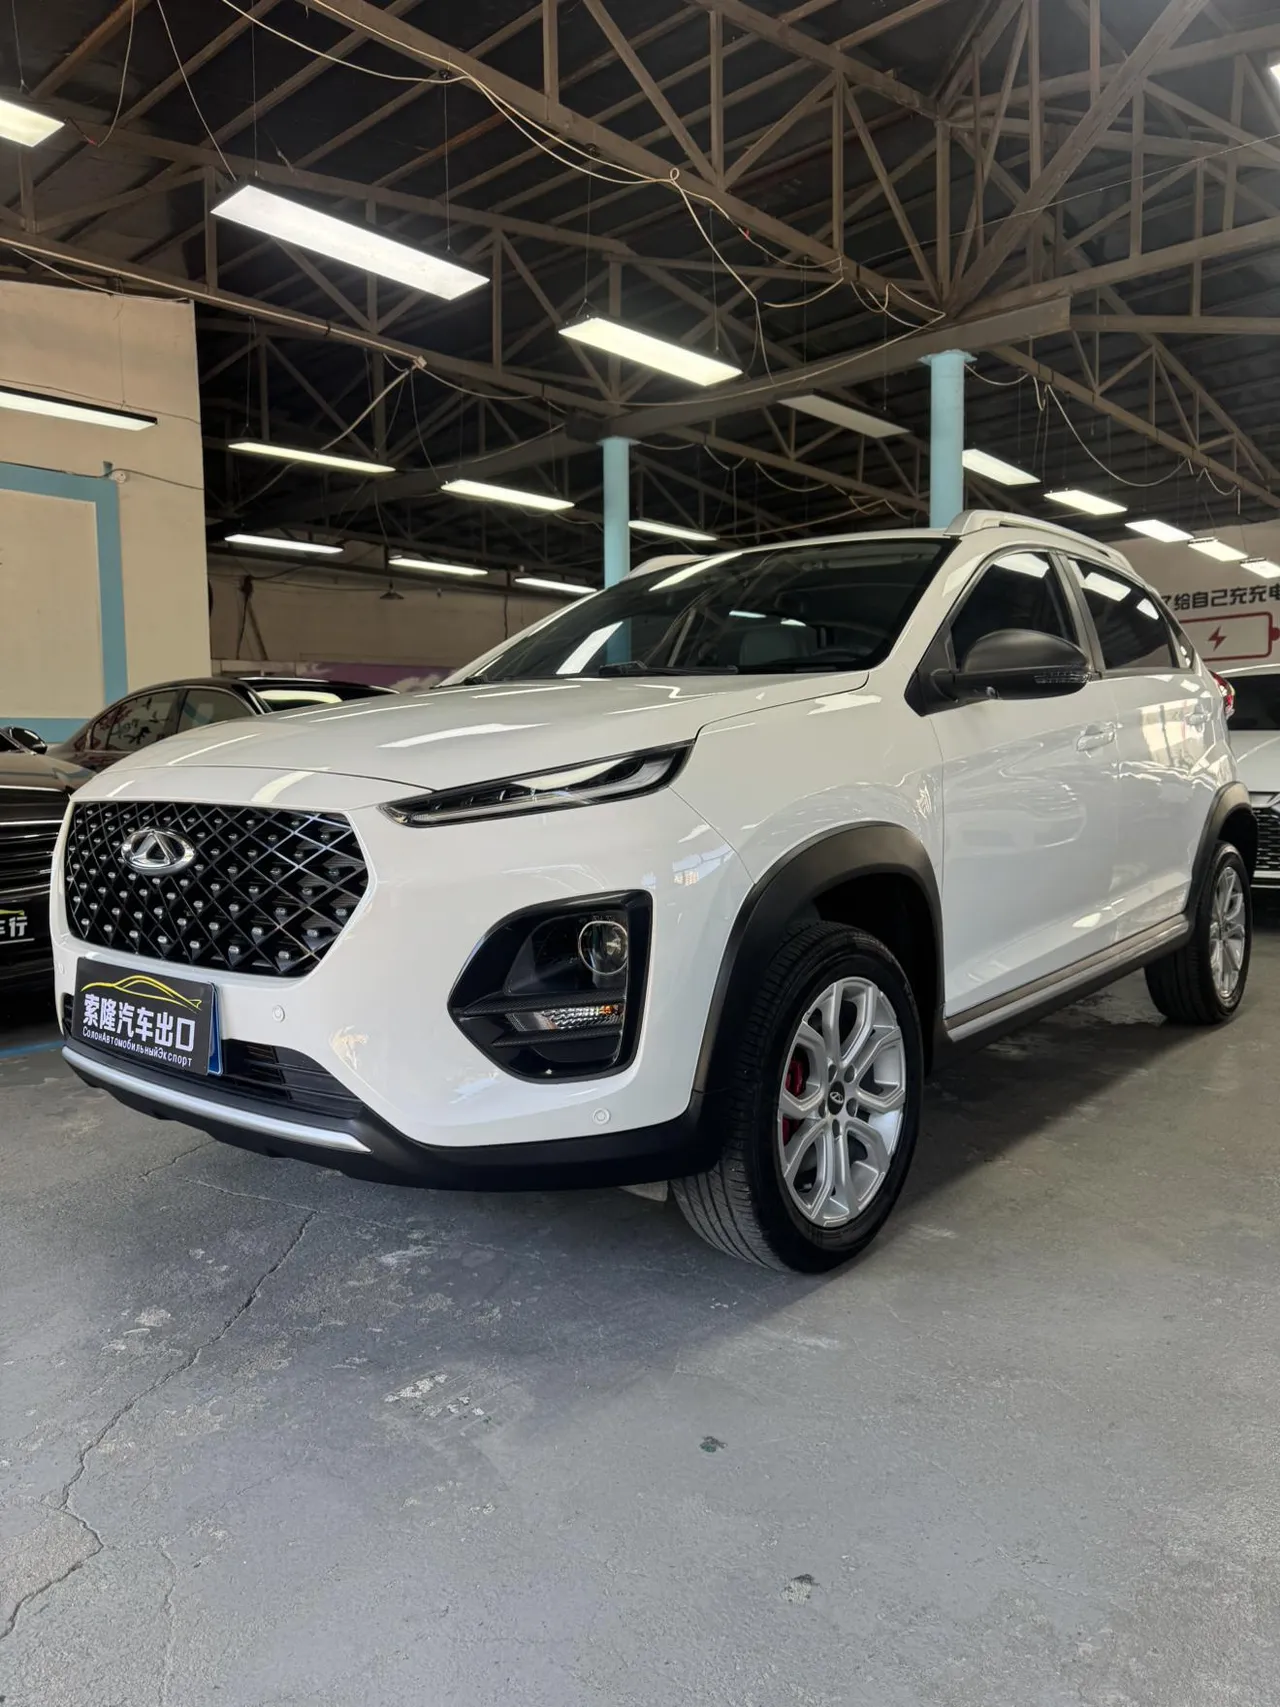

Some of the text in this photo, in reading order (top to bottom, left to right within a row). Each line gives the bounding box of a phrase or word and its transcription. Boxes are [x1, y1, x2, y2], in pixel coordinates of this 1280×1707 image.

[83, 993, 196, 1052] 索隆汽车出口
